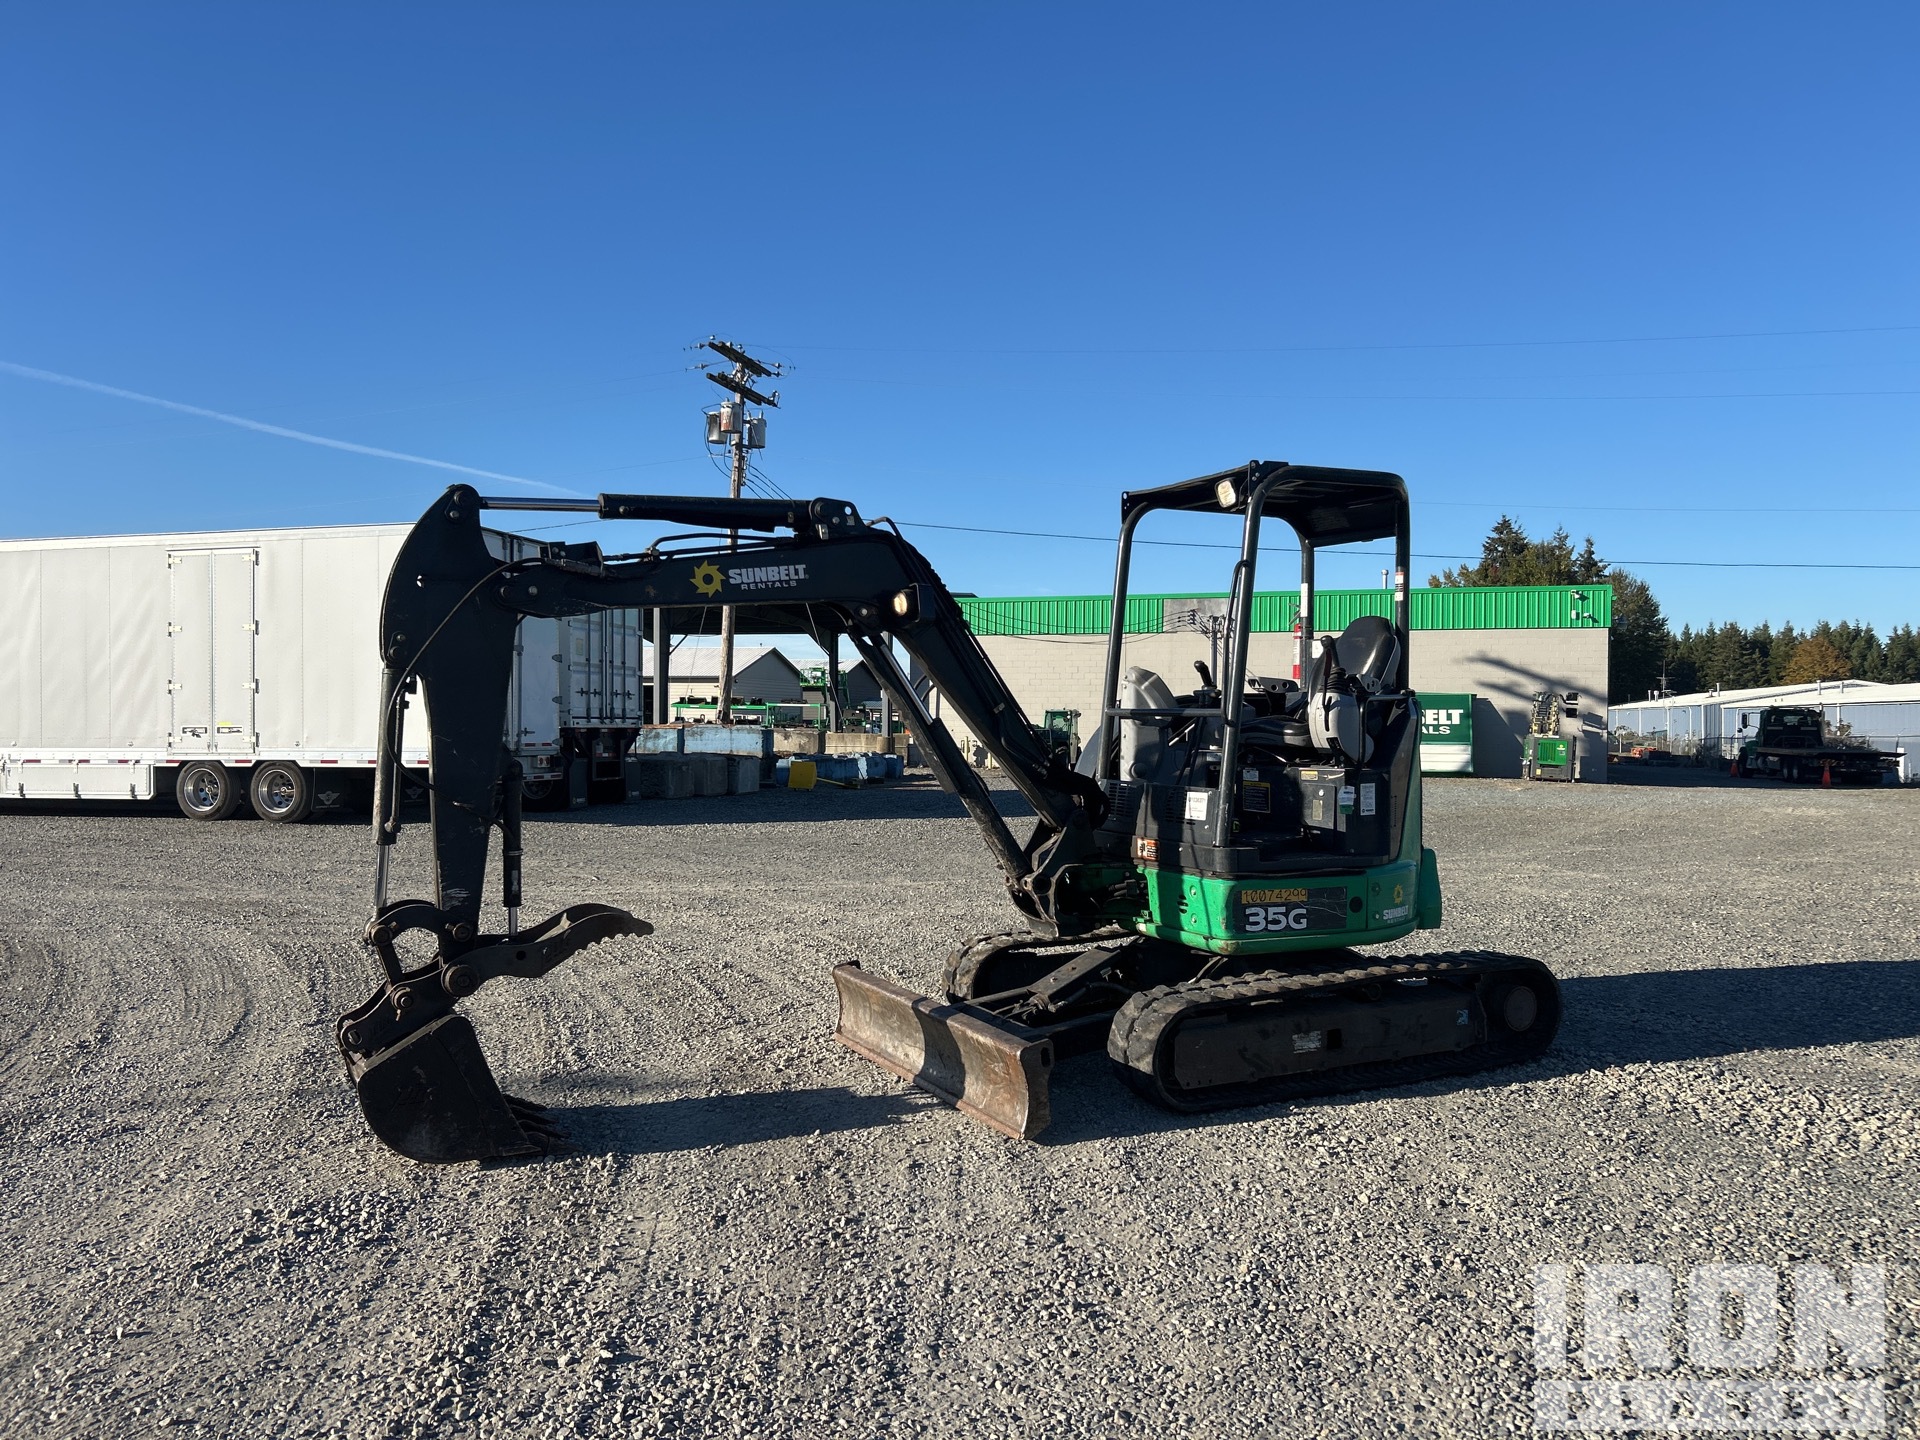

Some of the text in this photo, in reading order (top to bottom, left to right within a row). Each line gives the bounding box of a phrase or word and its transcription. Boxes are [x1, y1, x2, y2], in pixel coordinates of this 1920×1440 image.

[728, 564, 807, 584] SUNBELT
[741, 580, 797, 591] RENTALS
[1243, 888, 1307, 904] 10074299
[1245, 906, 1307, 932] 35G
